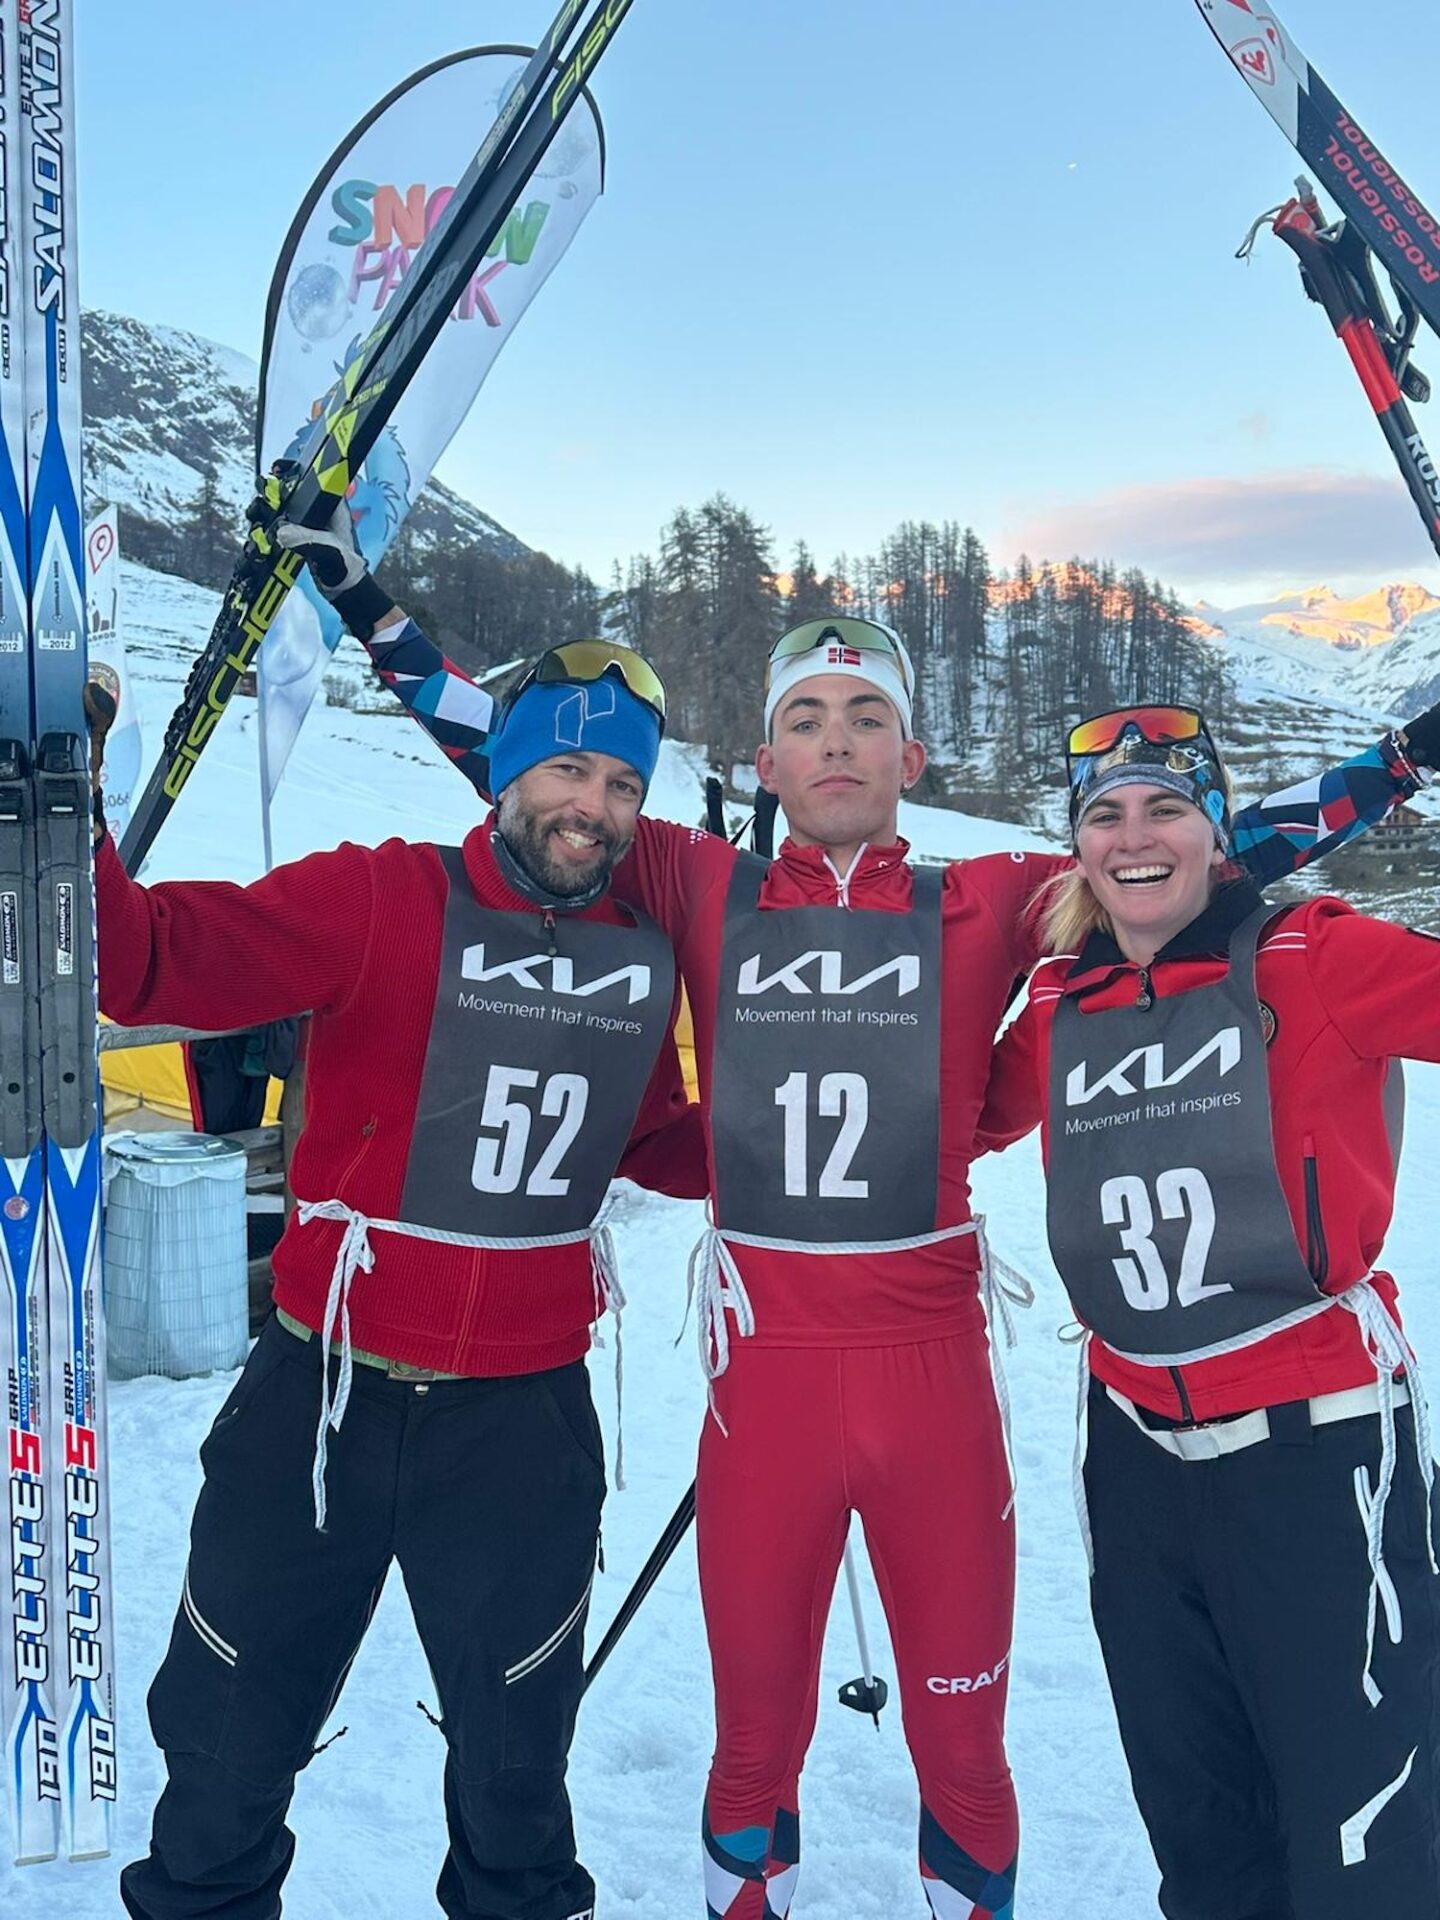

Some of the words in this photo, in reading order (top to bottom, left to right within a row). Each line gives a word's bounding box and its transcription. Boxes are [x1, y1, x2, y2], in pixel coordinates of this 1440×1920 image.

[20, 0, 31, 24] GR
[20, 32, 31, 47] 5
[20, 53, 32, 116] ELITE
[551, 0, 627, 120] FISC
[33, 0, 66, 323] SALOMON
[1325, 134, 1439, 284] ROSSIGNOL
[347, 242, 510, 328] PAK
[50, 641, 71, 649] 2012
[461, 943, 650, 1005] KIA
[737, 951, 920, 997] KIA
[457, 992, 545, 1019] Movement
[551, 1006, 582, 1025] that
[586, 1012, 643, 1034] inspires
[735, 1007, 816, 1023] Movement
[821, 1008, 852, 1023] that
[857, 1009, 918, 1027] inspires
[1066, 1026, 1241, 1106] KIA
[471, 1065, 589, 1196] 52
[775, 1072, 869, 1198] 12
[1065, 1107, 1141, 1135] Movement
[1145, 1102, 1176, 1119] that
[1181, 1091, 1242, 1114] inspires
[1100, 1167, 1234, 1311] 32
[8, 1368, 18, 1421] GRIP
[64, 1363, 75, 1416] GRIP
[9, 1427, 41, 1476] 5
[64, 1422, 96, 1473] 5
[10, 1477, 48, 1688] ELITE
[66, 1473, 102, 1688] ELITE
[927, 1650, 1009, 1694] CRAF
[36, 1717, 61, 1802] 190
[90, 1715, 117, 1802] 190
